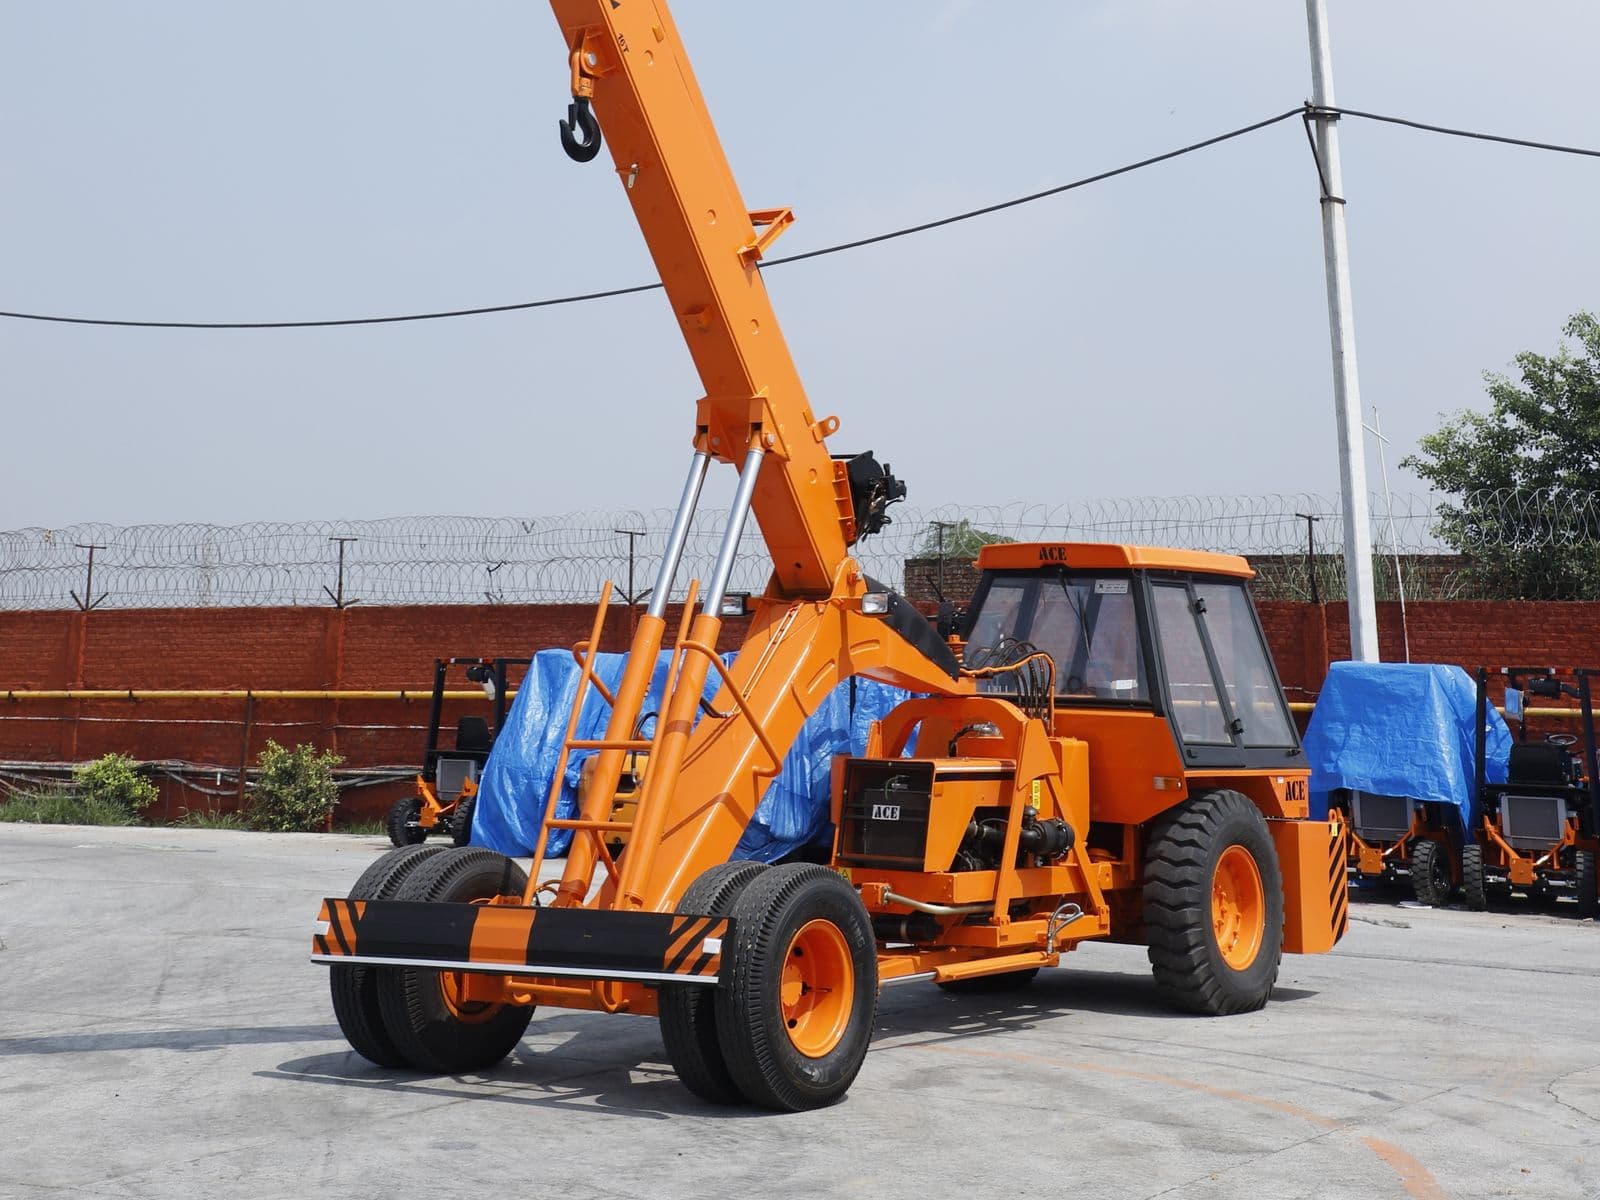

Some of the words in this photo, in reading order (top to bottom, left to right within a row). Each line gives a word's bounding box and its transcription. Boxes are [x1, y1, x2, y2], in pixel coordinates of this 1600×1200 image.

[617, 33, 629, 54] 16T
[1040, 547, 1066, 561] ACE
[1285, 781, 1305, 801] ACE
[874, 805, 899, 819] ACE
